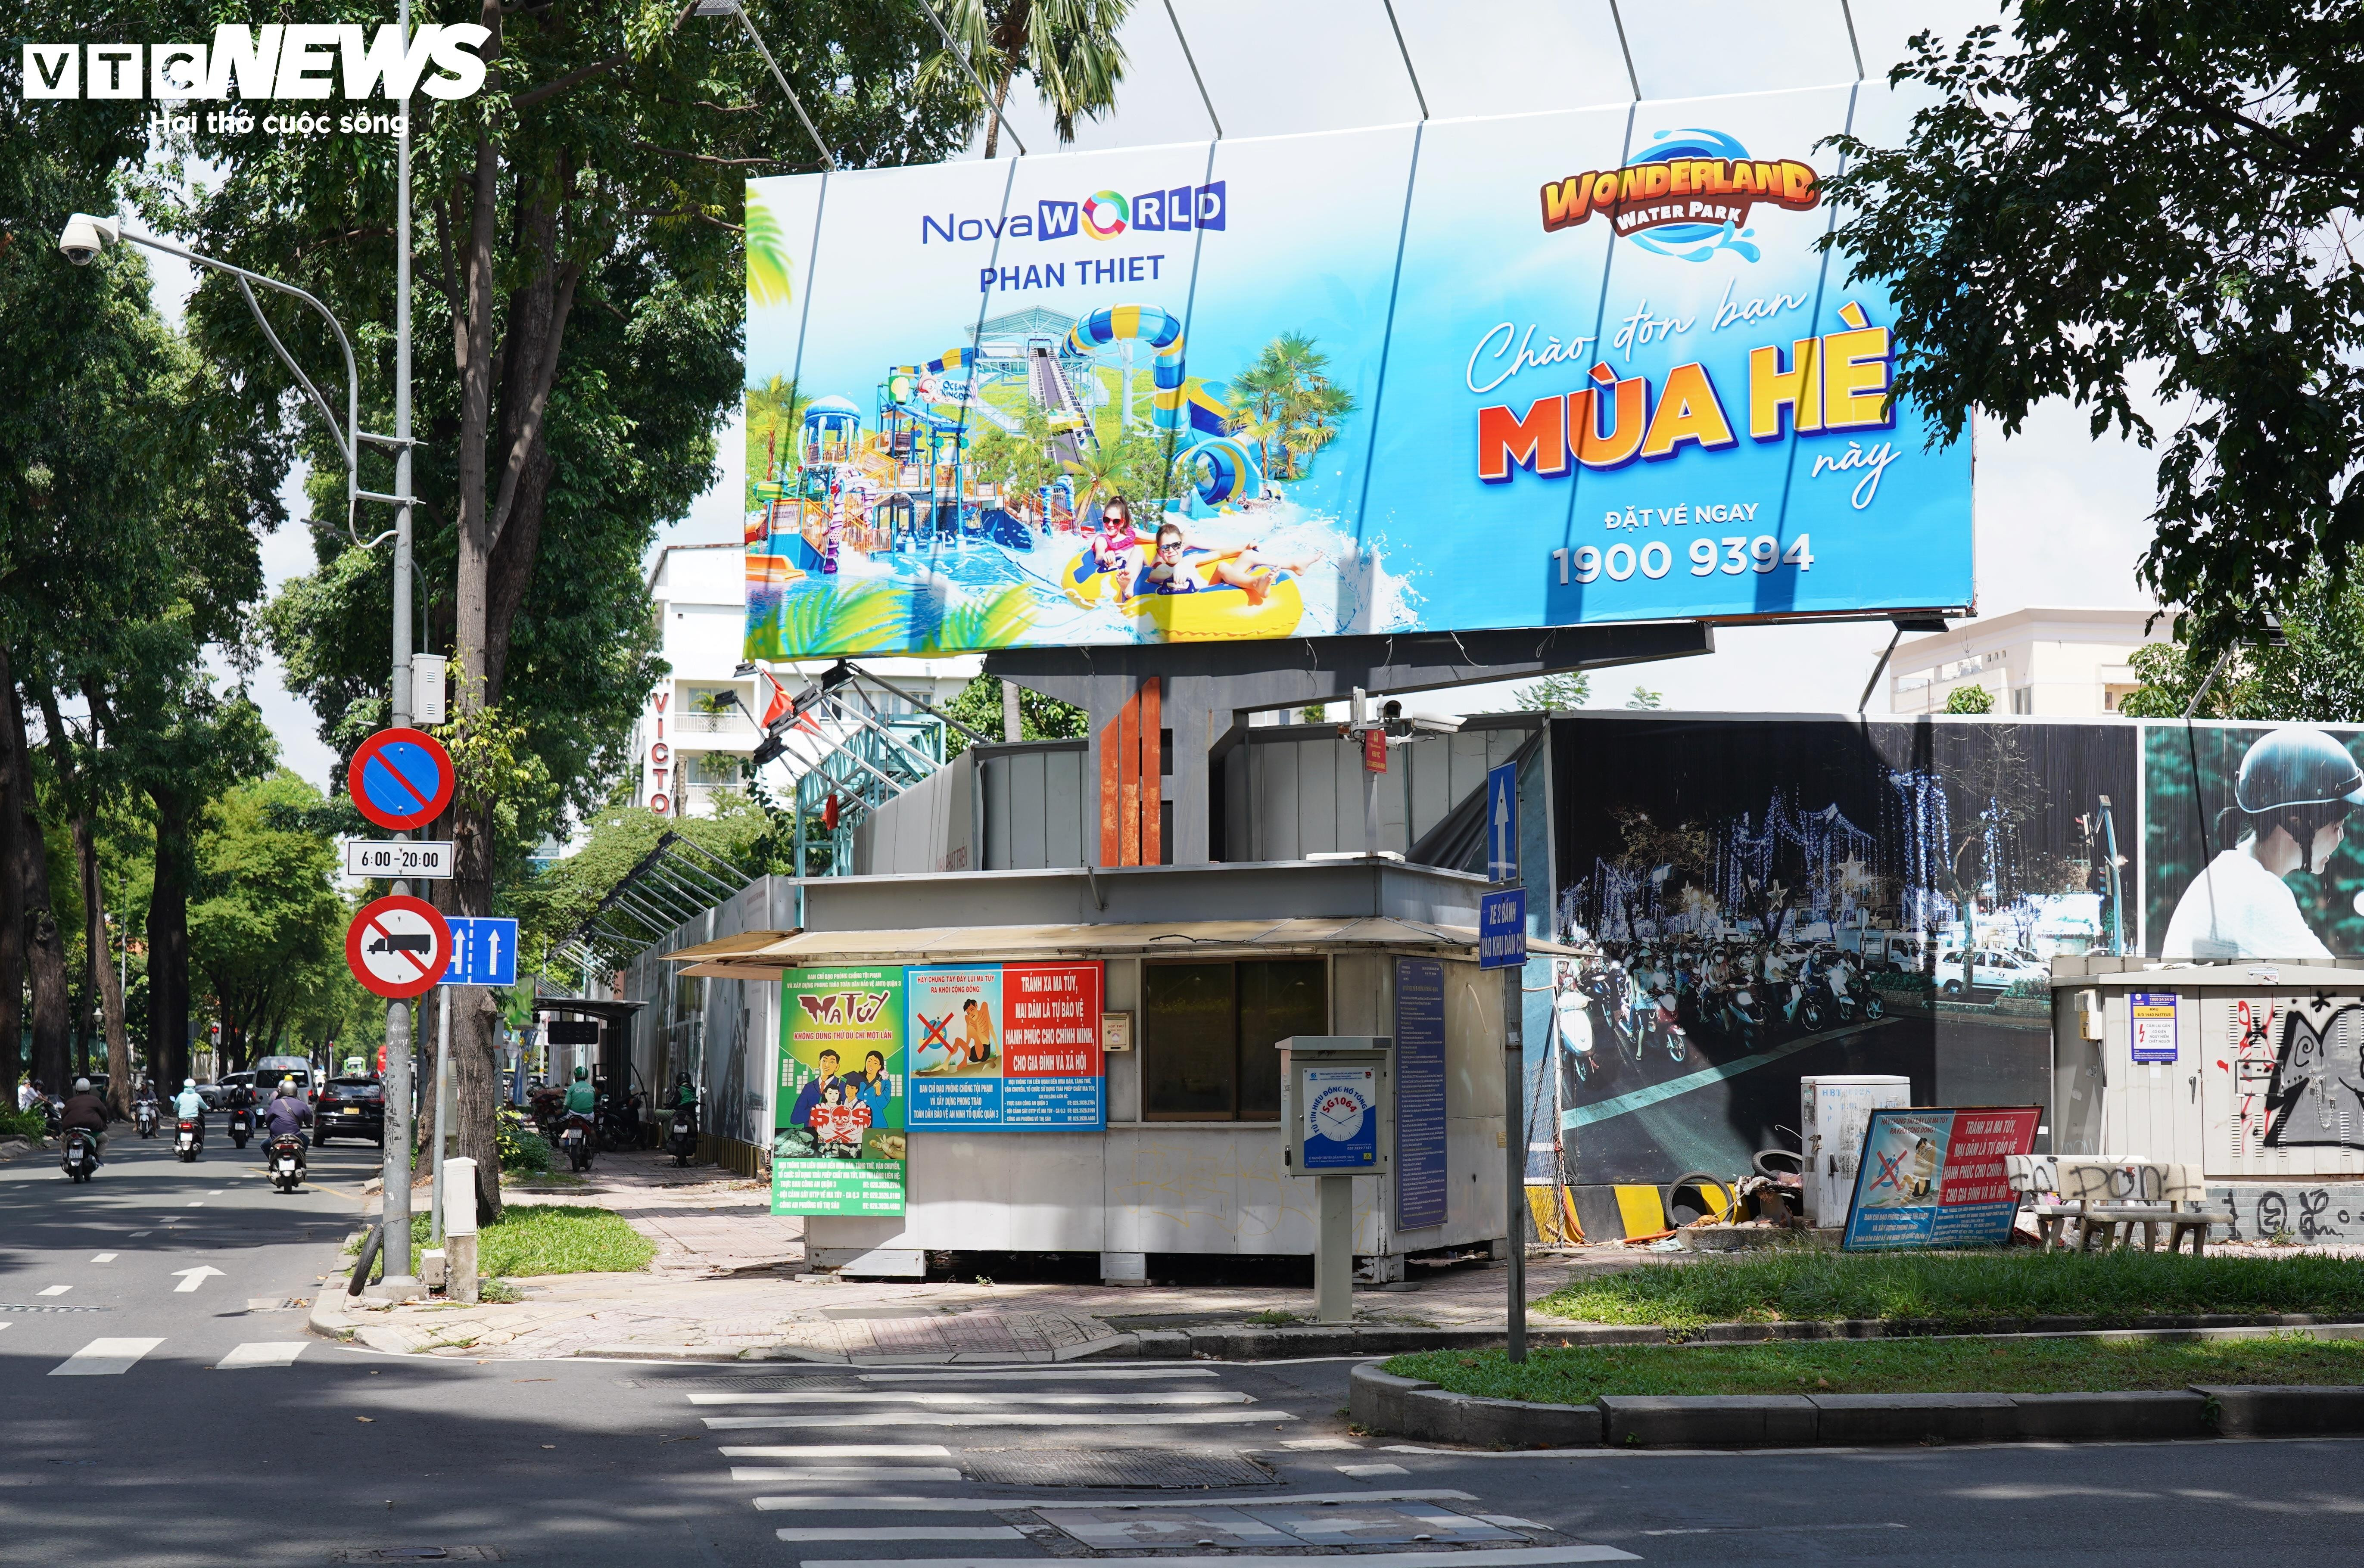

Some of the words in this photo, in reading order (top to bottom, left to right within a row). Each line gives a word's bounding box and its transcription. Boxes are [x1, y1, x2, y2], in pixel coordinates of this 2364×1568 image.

[1545, 158, 1818, 221] WONDERLAND
[1616, 203, 1684, 231] WATER
[1688, 200, 1742, 221] PARK
[980, 262, 1064, 292] PHAN
[1075, 255, 1165, 285] THIET
[1466, 322, 1597, 393] Chào
[1613, 298, 1695, 361] đón
[1712, 276, 1807, 332] bạn
[943, 381, 968, 390] OCEAN
[1478, 361, 1739, 484] MÙA
[1749, 300, 1896, 438] HÈ
[1811, 442, 1901, 509] này
[1605, 508, 1653, 533] ĐẶT
[1660, 502, 1686, 526] VÉ
[1695, 502, 1758, 523] NGAY
[1552, 541, 1672, 585] 1900
[1689, 534, 1815, 576] 9394
[1489, 904, 1497, 925] XE
[1498, 903, 1501, 924] 2
[1502, 897, 1516, 923] BÁNH
[1482, 932, 1492, 958] VÀO
[1493, 935, 1503, 957] KHU
[1504, 930, 1515, 955] DÂN
[1517, 927, 1524, 953] CƯ
[1022, 972, 1042, 992] TRÁNH
[1043, 976, 1052, 992] XA
[1053, 976, 1062, 991] MA
[1064, 971, 1078, 994] TÚY,
[798, 994, 841, 1025] MA
[839, 991, 889, 1025] TÚY
[1015, 1003, 1027, 1023] MẠI
[1028, 999, 1041, 1018] DÂM
[1043, 998, 1050, 1018] LÀ
[1052, 999, 1060, 1022] TỰ
[1062, 996, 1074, 1017] BẢO
[1075, 998, 1084, 1021] VỆ
[794, 1031, 813, 1040] KHÔNG
[816, 1030, 831, 1039] DÙNG
[833, 1030, 844, 1039] THỬ
[846, 1031, 853, 1039] DÙ
[855, 1030, 865, 1039] CHỈ
[867, 1030, 879, 1040] MỘT
[881, 1029, 892, 1039] LẦN
[1006, 1029, 1023, 1049] HẠNH
[1024, 1024, 1040, 1045] PHÚC
[1042, 1028, 1054, 1044] CHO
[1056, 1024, 1075, 1044] CHÍNH
[1077, 1024, 1094, 1046] MÌNH,
[1013, 1055, 1026, 1071] CHO
[1028, 1055, 1038, 1071] GIA
[1039, 1051, 1054, 1070] ĐÌNH
[1056, 1051, 1064, 1070] VÀ
[1065, 1050, 1074, 1070] XÃ
[1076, 1051, 1086, 1074] HỘI
[936, 1085, 944, 1094] ĐẠO
[945, 1083, 959, 1092] PHÒNG
[959, 1082, 972, 1092] CHỐNG
[981, 1085, 993, 1094] PHẠM
[914, 1108, 924, 1118] TOÀN
[925, 1108, 933, 1118] DÂN
[934, 1108, 943, 1118] BẢO
[943, 1108, 948, 1120] VỆ
[966, 1106, 972, 1118] TỔ
[972, 1107, 983, 1119] QUỐC
[984, 1108, 995, 1120] QUẬN
[930, 1095, 935, 1105] VÀ
[945, 1096, 956, 1107] DỰNG
[971, 1095, 981, 1105] TRÀO
[1322, 1097, 1358, 1113] SG1064
[1965, 1118, 1985, 1134] TRÁNH
[1984, 1121, 1992, 1133] XA
[1993, 1120, 2003, 1133] MA
[2003, 1117, 2016, 1136] TÚY,
[1954, 1143, 1966, 1160] MẠI
[1965, 1139, 1979, 1156] DÂM
[1978, 1139, 1986, 1155] LÀ
[1987, 1140, 1996, 1157] TỰ
[1995, 1136, 2007, 1154] BẢO
[1943, 1166, 1959, 1182] HẠNH
[1959, 1161, 1974, 1179] PHÚC
[1975, 1166, 1986, 1178] CHO
[1987, 1160, 2003, 1177] CHÍNH
[1946, 1188, 1957, 1202] CHO
[1958, 1187, 1967, 1201] GIA
[1968, 1184, 1981, 1201] ĐÌNH
[1981, 1183, 1989, 1199] VÀ
[1989, 1183, 1997, 1199] XÃ
[1998, 1181, 2008, 1201] HỘI
